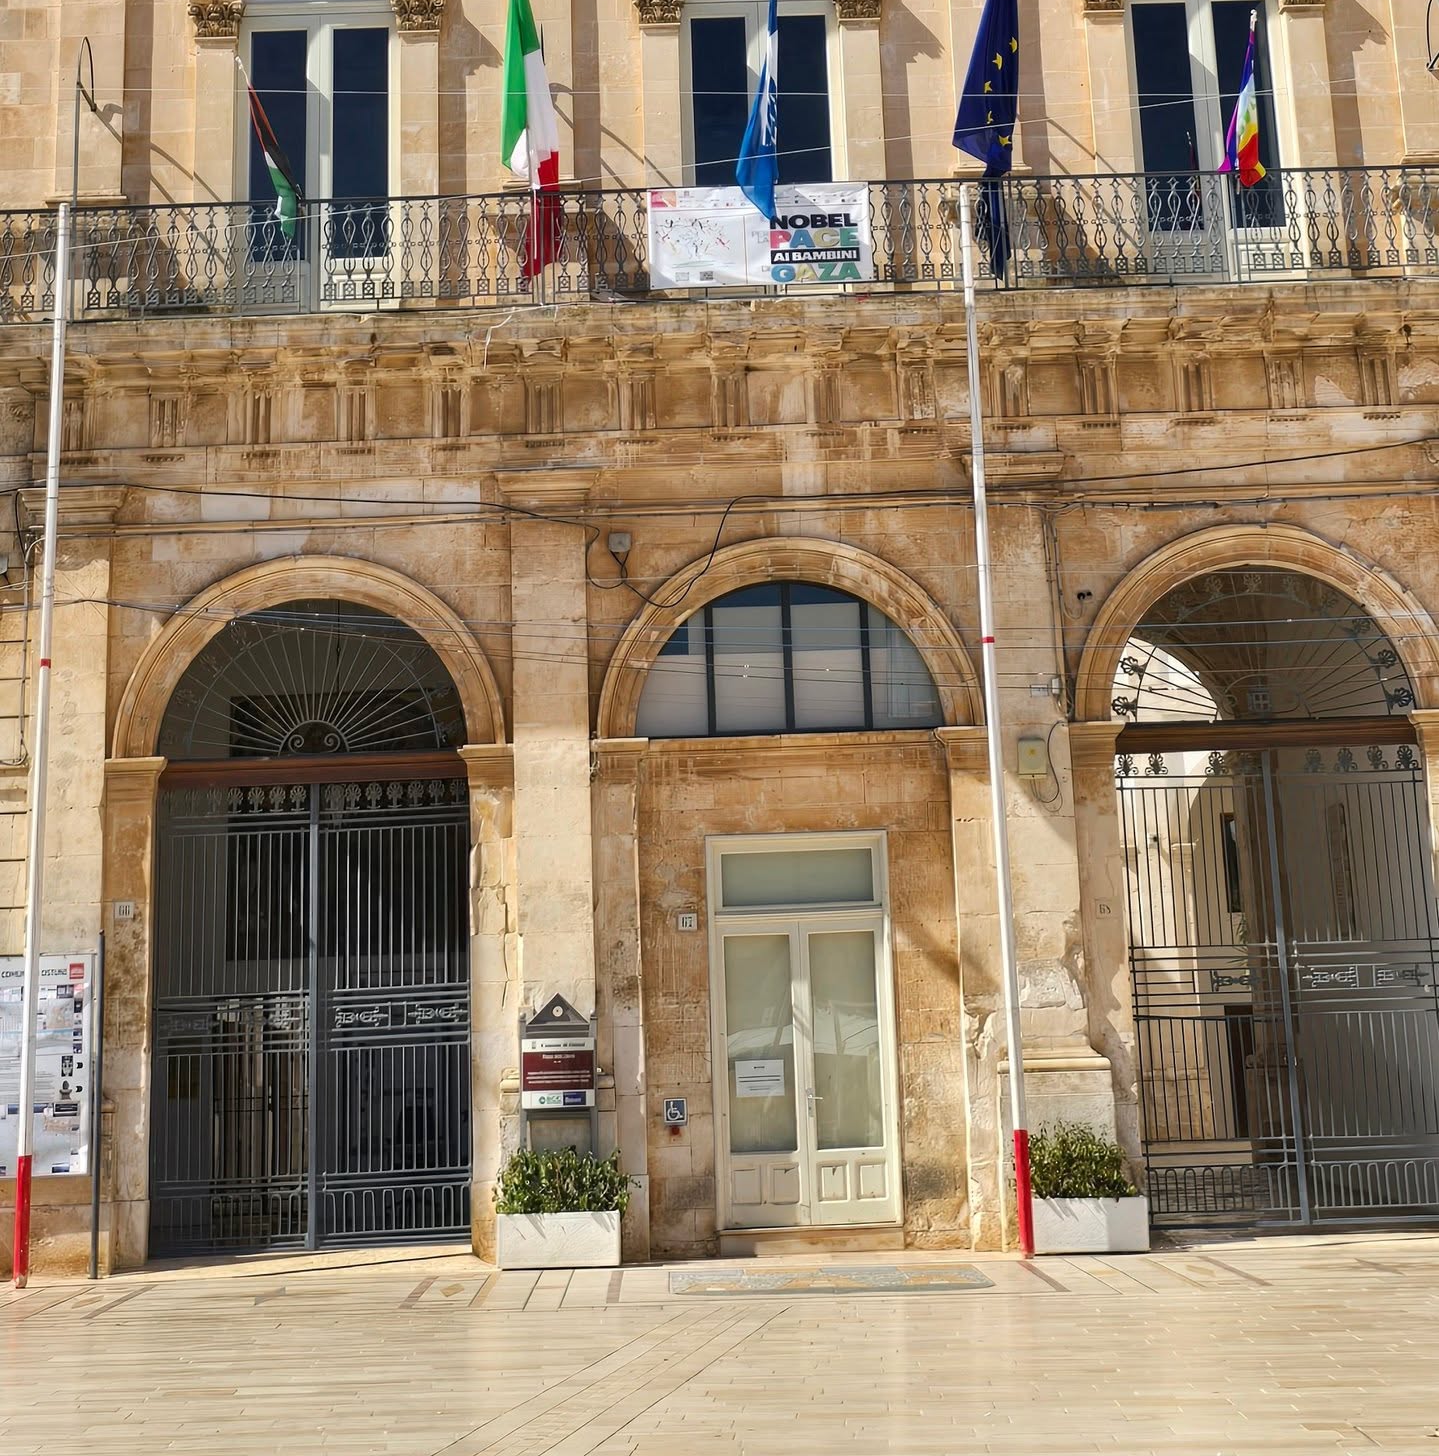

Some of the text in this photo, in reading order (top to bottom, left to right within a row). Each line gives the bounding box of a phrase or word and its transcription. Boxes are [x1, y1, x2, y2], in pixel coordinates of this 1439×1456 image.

[770, 213, 857, 229] NOBEL
[770, 228, 860, 249] PACE
[773, 250, 857, 262] AI BAMBINI
[771, 262, 862, 282] GAZA
